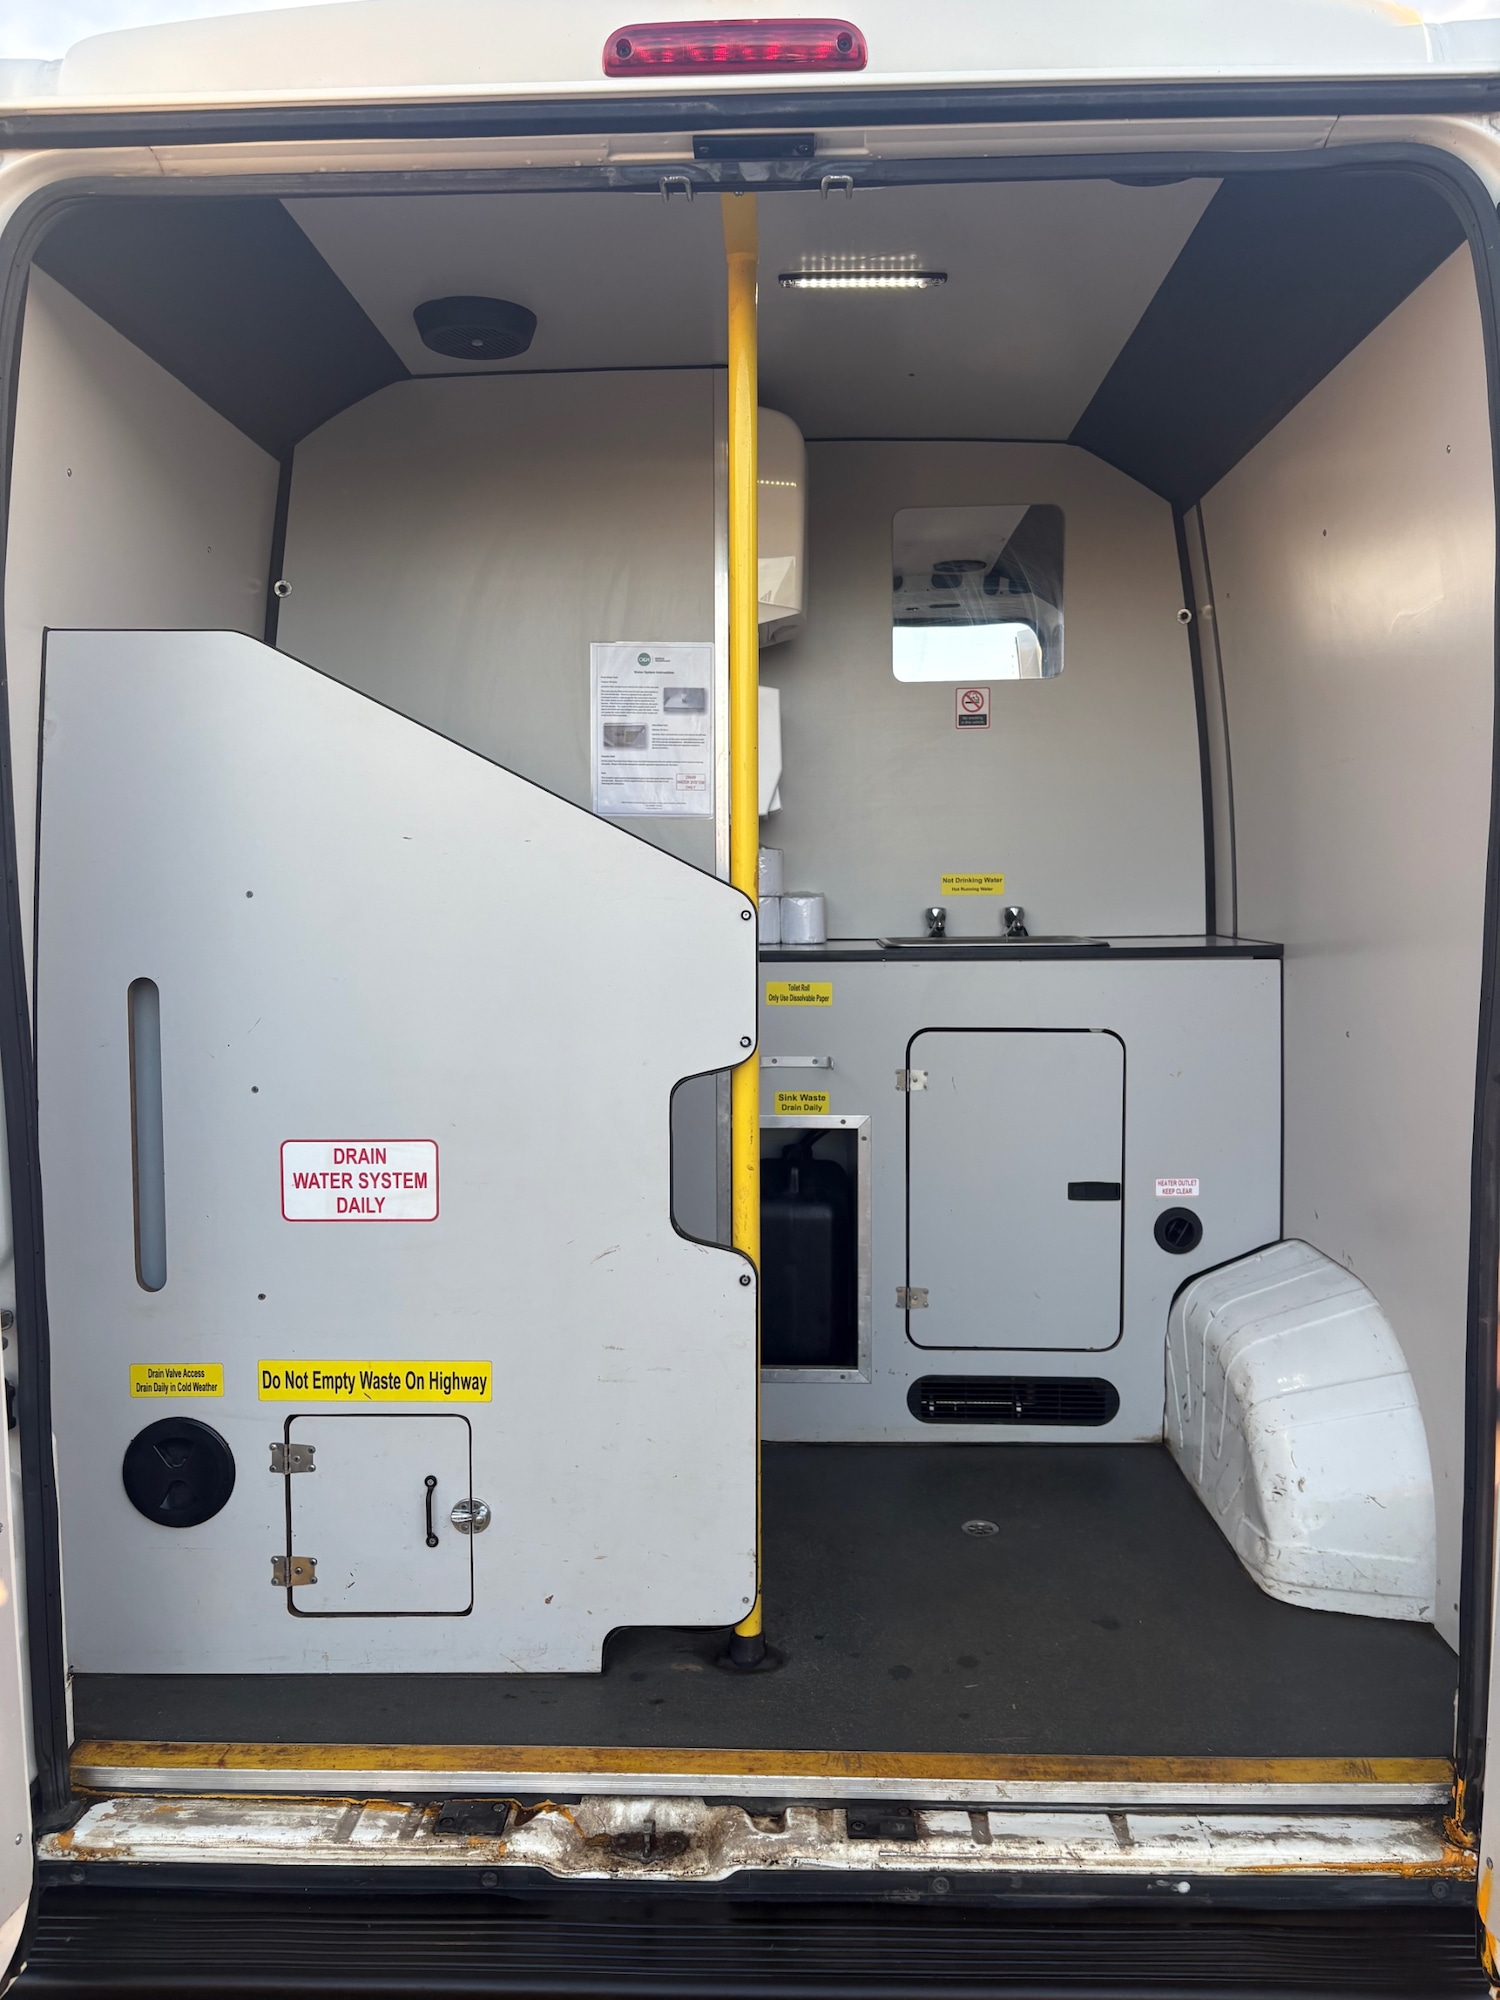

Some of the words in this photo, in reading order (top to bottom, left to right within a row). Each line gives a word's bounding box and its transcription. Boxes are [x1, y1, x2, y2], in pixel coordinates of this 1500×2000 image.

[768, 993, 779, 1003] Only
[790, 994, 815, 1002] Dissolvable
[816, 994, 829, 1004] Paper
[778, 1093, 798, 1101] Sink
[803, 1104, 823, 1112] Daily
[333, 1148, 387, 1165] DRAIN
[293, 1172, 353, 1189] WATER
[358, 1172, 427, 1189] SYSTEM
[337, 1197, 386, 1214] DAILY
[148, 1368, 164, 1378] Drain
[165, 1368, 182, 1378] Valve
[182, 1368, 205, 1378] Access
[136, 1382, 152, 1392] Drain
[153, 1382, 168, 1395] Daily
[170, 1382, 176, 1392] in
[177, 1382, 191, 1392] Cold
[193, 1382, 218, 1392] Weather
[262, 1370, 281, 1389] Do
[285, 1370, 309, 1389] Not
[313, 1371, 355, 1394] Empty
[359, 1371, 401, 1390] Waste
[405, 1371, 424, 1390] On
[429, 1371, 487, 1395] Highway
